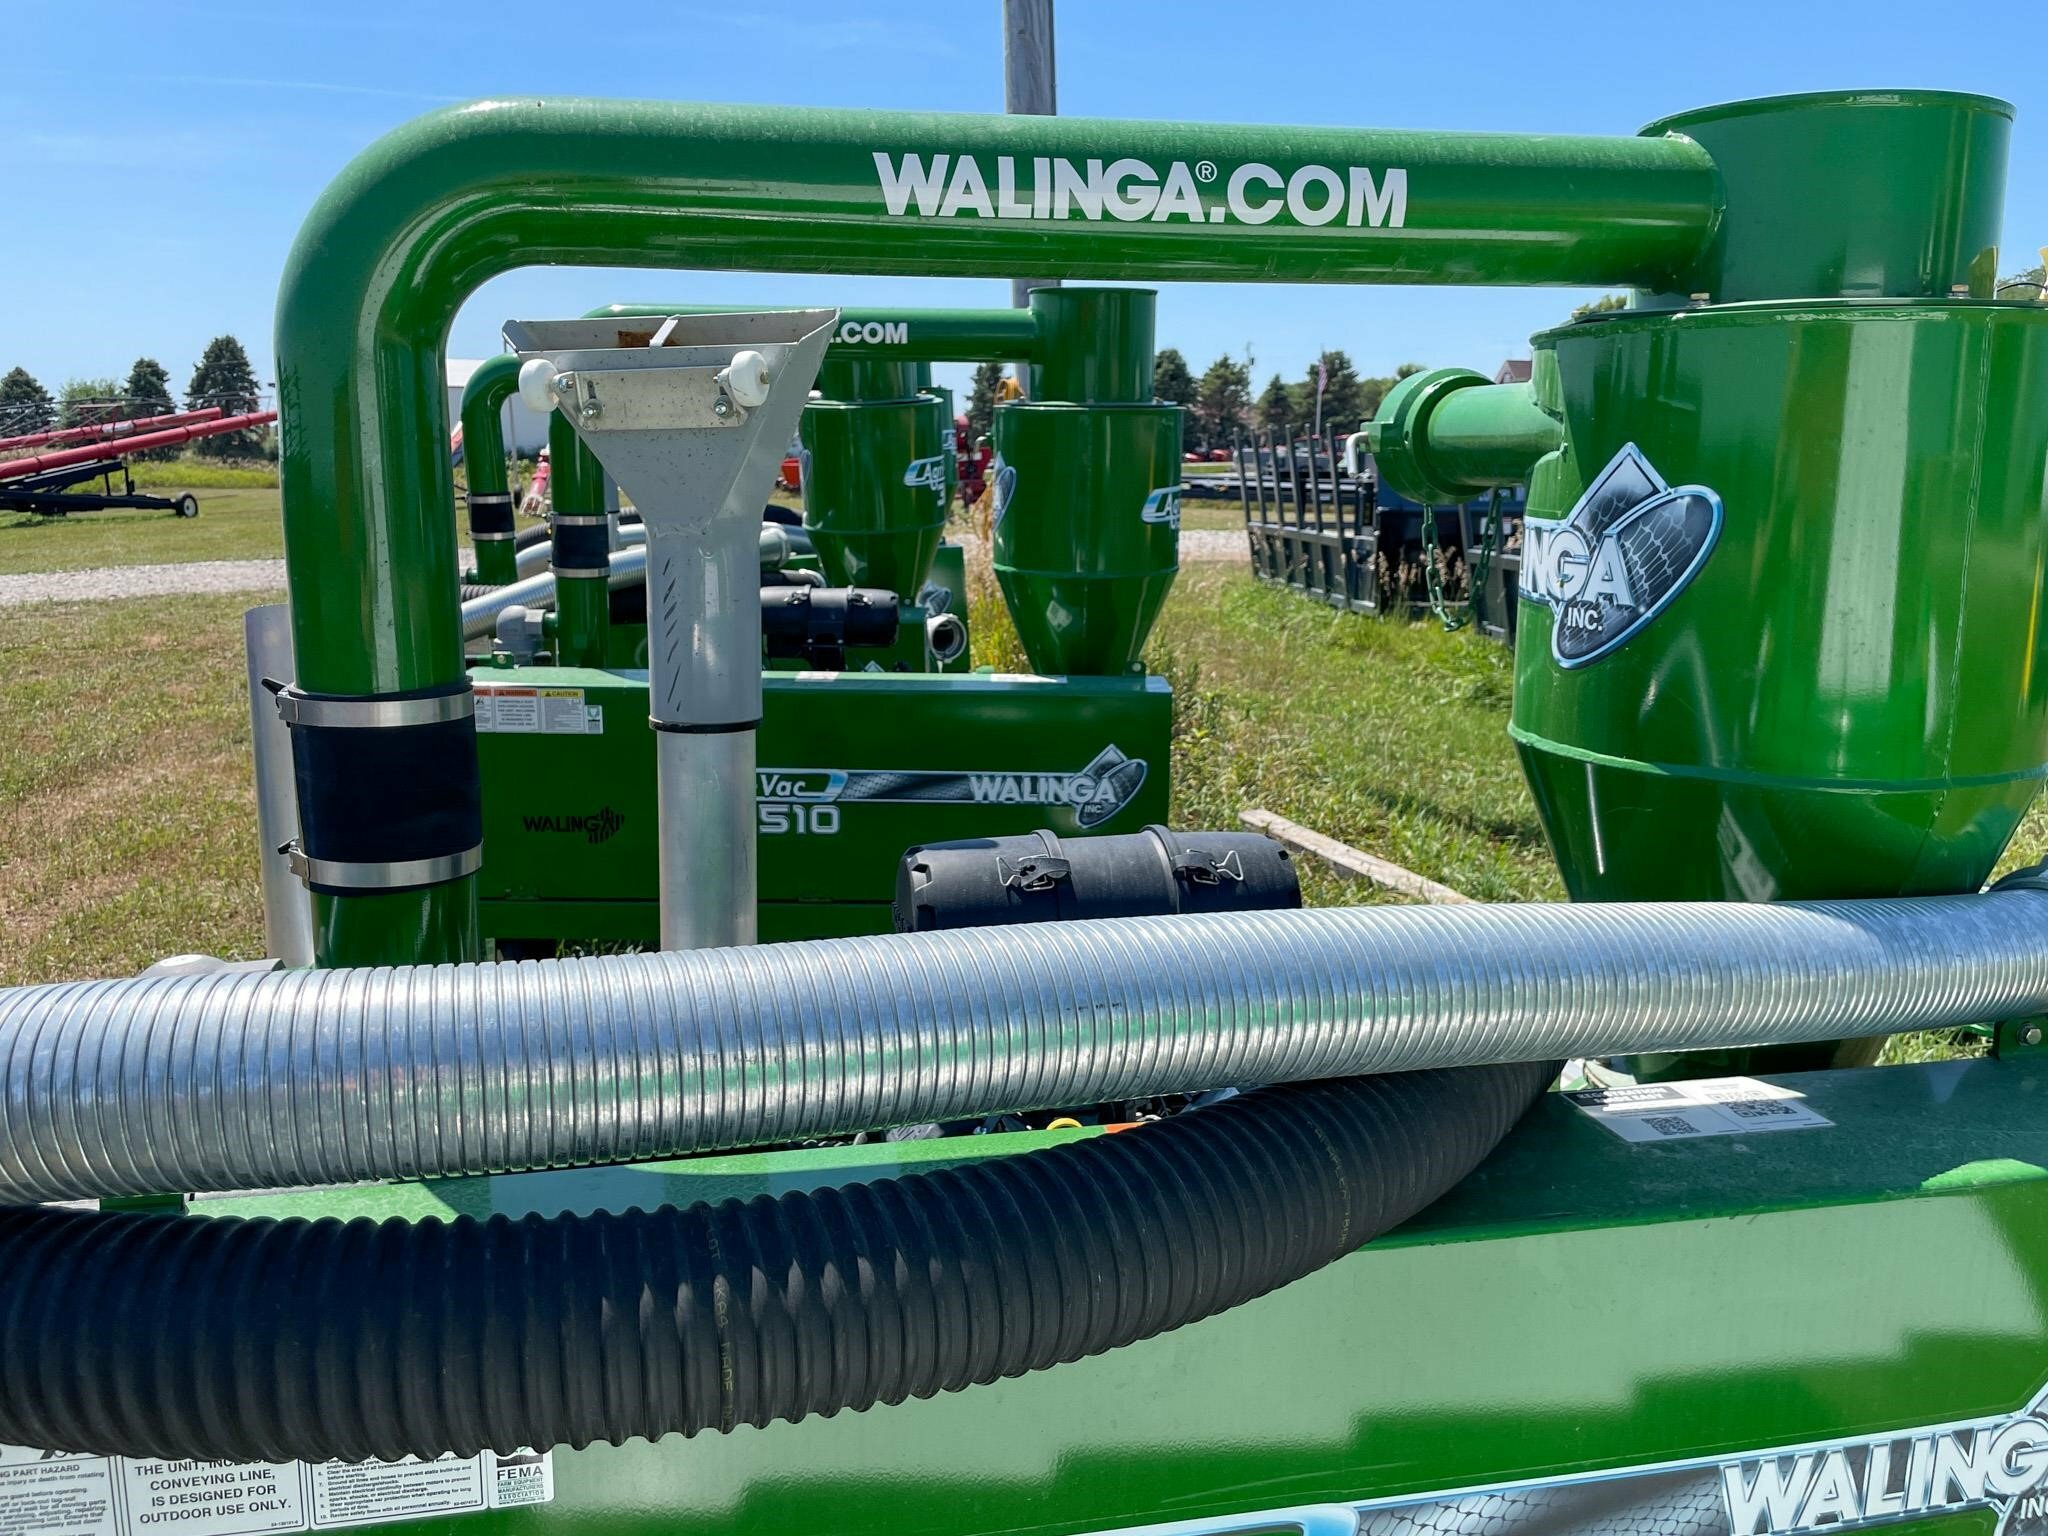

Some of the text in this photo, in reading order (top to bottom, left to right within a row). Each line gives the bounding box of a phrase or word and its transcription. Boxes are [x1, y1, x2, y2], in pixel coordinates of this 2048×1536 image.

[829, 322, 908, 345] .COM
[1519, 525, 1637, 607] INGA
[1567, 607, 1603, 631] INC.
[968, 775, 1118, 804] WALINGA
[759, 804, 840, 833] 510
[13, 1468, 38, 1476] PART
[41, 1464, 80, 1474] HAZARD
[135, 1464, 163, 1476] THE
[168, 1461, 205, 1473] UNIT,
[150, 1469, 276, 1491] CONVEYING LINE,
[497, 1465, 544, 1481] FEMA
[1719, 1417, 2048, 1536] WALING
[152, 1484, 276, 1506] IS DESIGNED FOR
[499, 1489, 545, 1500] ASSOCIATION
[139, 1498, 292, 1524] OUTDOOR USE ONLY.
